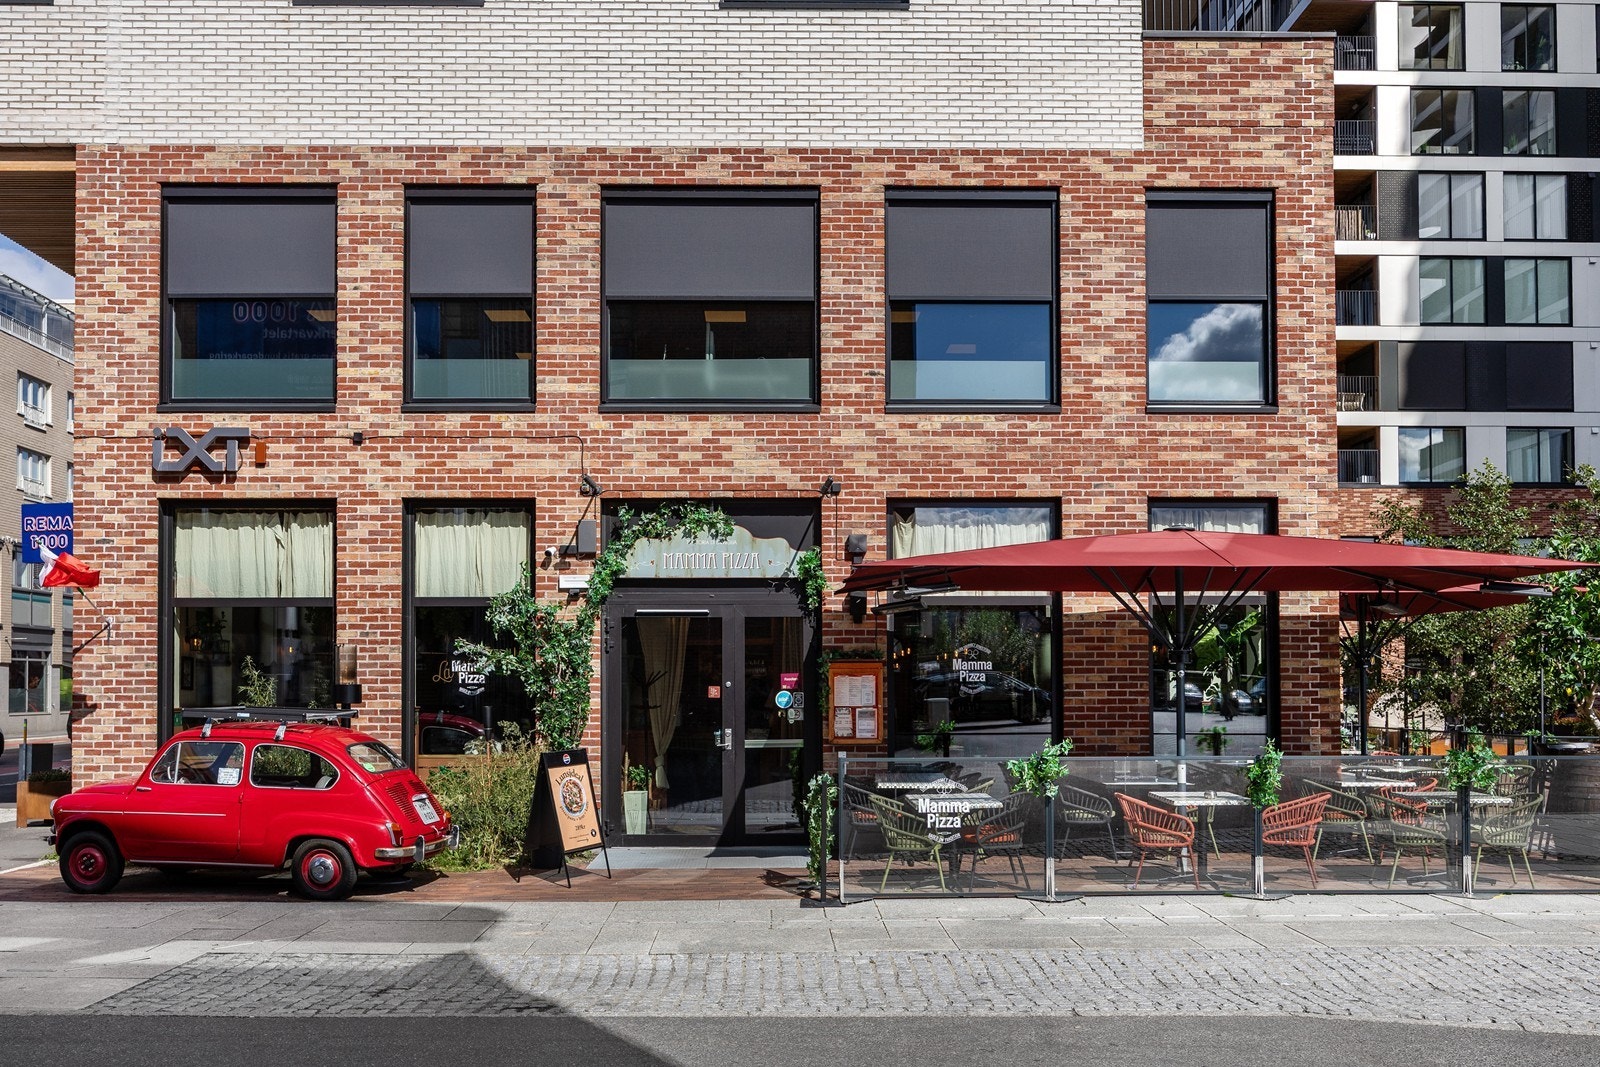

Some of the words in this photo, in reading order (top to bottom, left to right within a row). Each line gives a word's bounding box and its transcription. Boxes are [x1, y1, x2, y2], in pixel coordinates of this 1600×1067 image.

[24, 515, 73, 531] REMA
[30, 534, 68, 549] 1000
[663, 552, 717, 569] MAMMA
[722, 552, 760, 569] PIZZA
[952, 658, 993, 670] Mamma
[458, 671, 485, 684] Pizza
[959, 671, 986, 682] Pizza
[918, 798, 970, 813] Mamma
[927, 813, 961, 829] Pizza
